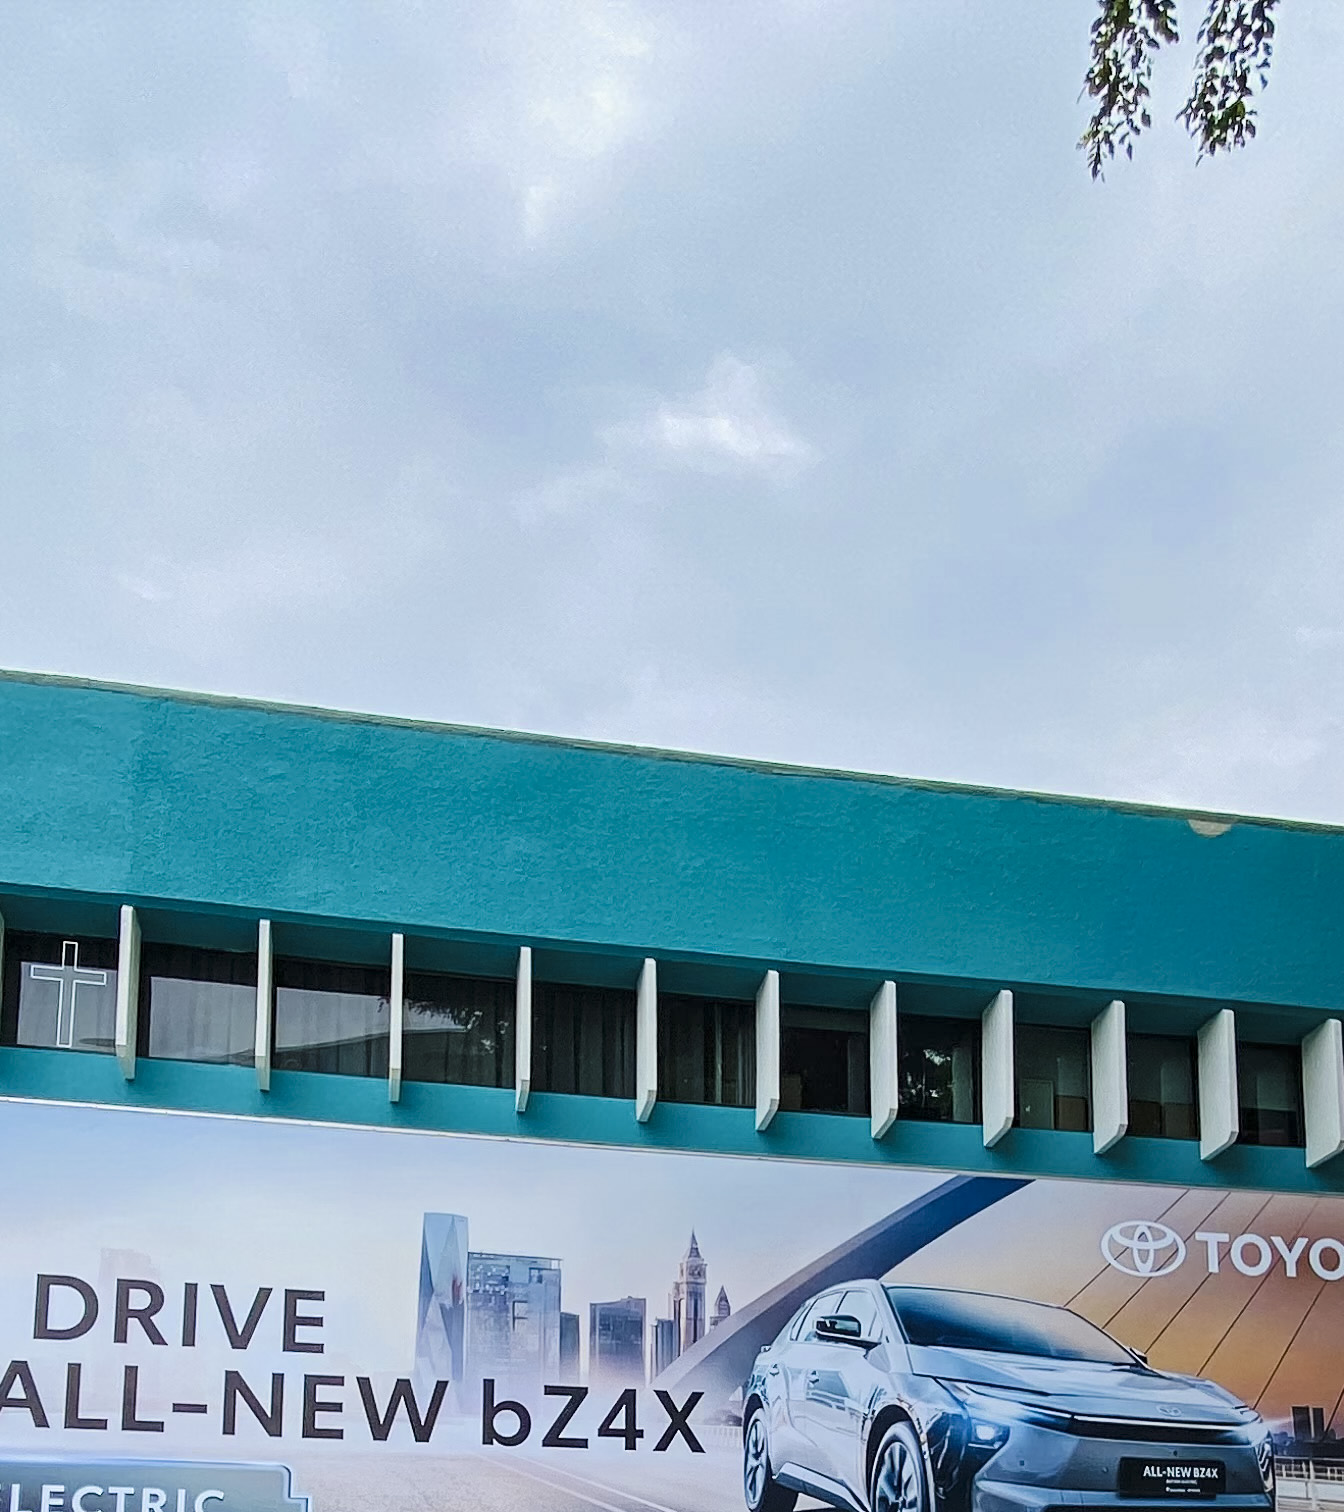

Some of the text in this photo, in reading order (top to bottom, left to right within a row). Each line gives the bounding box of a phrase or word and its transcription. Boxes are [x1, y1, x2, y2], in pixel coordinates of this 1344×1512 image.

[32, 1273, 327, 1354] DRIVE
[481, 1377, 707, 1454] bZ4X
[1142, 1465, 1219, 1479] ALL-NEW BZ4X
